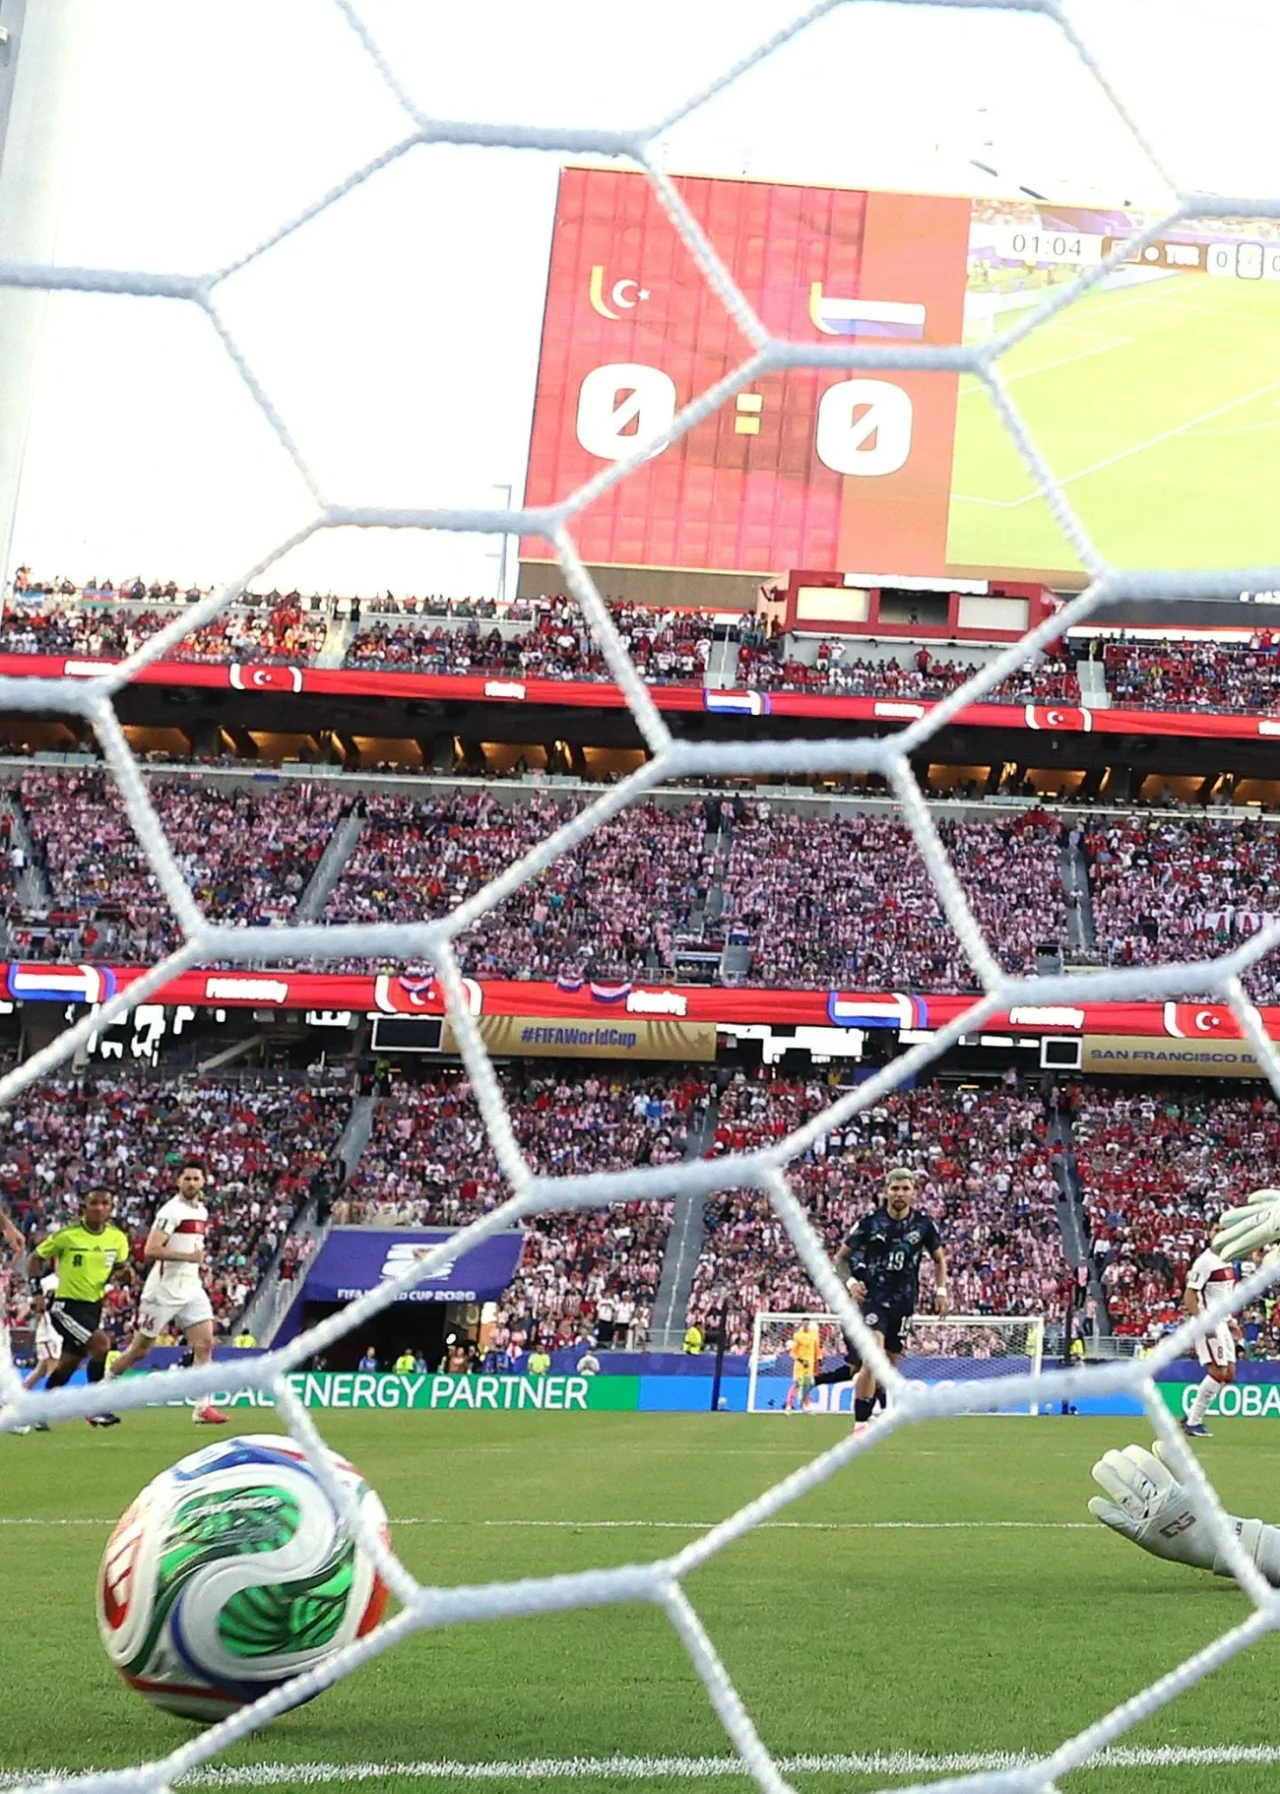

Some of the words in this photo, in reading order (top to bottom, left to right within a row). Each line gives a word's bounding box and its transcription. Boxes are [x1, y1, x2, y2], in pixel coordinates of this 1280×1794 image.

[1012, 233, 1083, 258] 01:04
[576, 362, 677, 461] 0
[816, 378, 913, 477] 0
[521, 1026, 637, 1049] #FIFAWorldCup
[1091, 1049, 1129, 1061] SAN
[1132, 1050, 1237, 1064] FRANCISCO
[886, 1250, 905, 1271] 19
[409, 1290, 434, 1301] CUP
[284, 1374, 426, 1408] ENERGY
[430, 1374, 589, 1410] PARTNER
